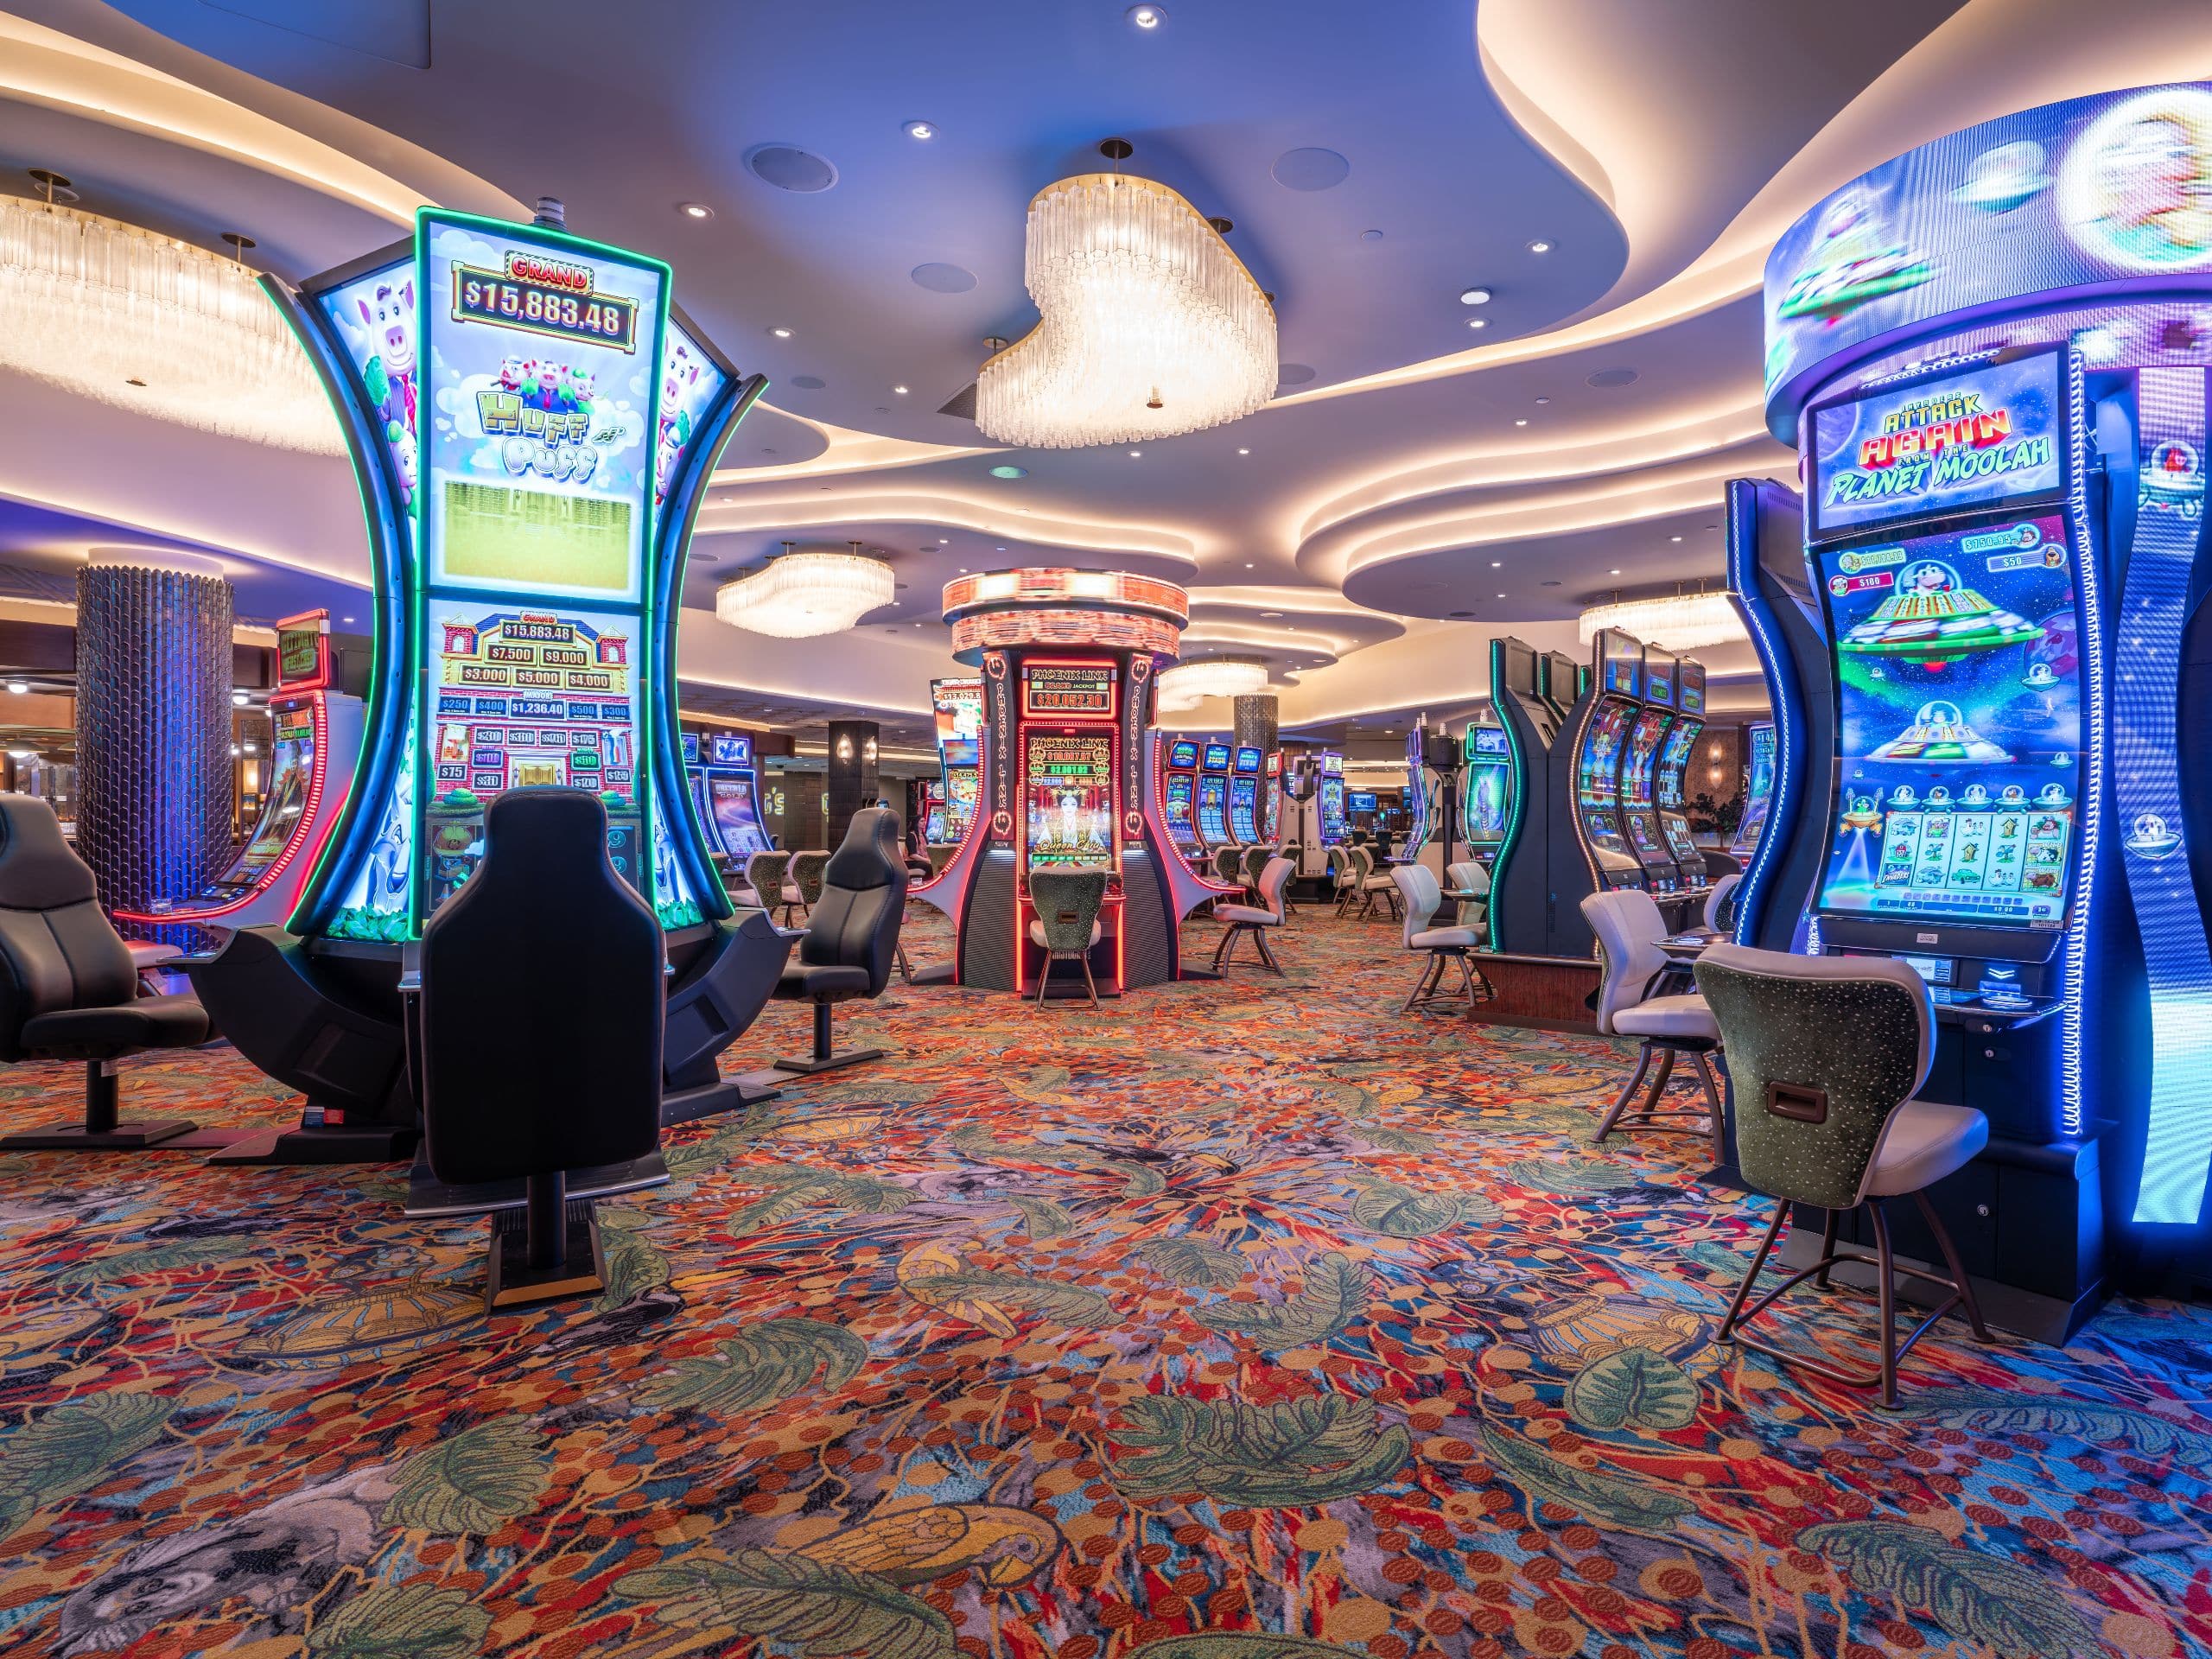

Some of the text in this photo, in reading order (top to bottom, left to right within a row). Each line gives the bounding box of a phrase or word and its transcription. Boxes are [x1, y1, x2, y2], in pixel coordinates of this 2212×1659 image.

[511, 256, 588, 288] GRAND
[464, 281, 620, 336] $15,883.48
[1901, 391, 1962, 411] INVADERS
[1884, 393, 1983, 434] ATTACK
[1858, 408, 2014, 469] AGAIN
[1897, 444, 1969, 467] FROM THE
[1824, 436, 2050, 509] PLANET MOOLAH
[2003, 556, 2022, 567] $50
[1859, 576, 1880, 587] $100
[522, 613, 556, 624] GRAND
[505, 623, 569, 639] $15,883.48
[492, 647, 584, 664] $7,500 $9,000
[465, 668, 608, 687] $3,000 $5,000 $4,000
[1031, 669, 1109, 681] PHOENIX LINK
[443, 699, 468, 709] $250
[479, 701, 504, 711] $400
[512, 702, 563, 715] $1,236.40
[571, 705, 594, 715] $500
[604, 707, 626, 716] $300
[1130, 685, 1141, 760] PHOENIX
[996, 683, 1007, 808] PHOENIX LINK
[1030, 737, 1109, 748] PHOENIX LINK
[442, 766, 462, 778] $75
